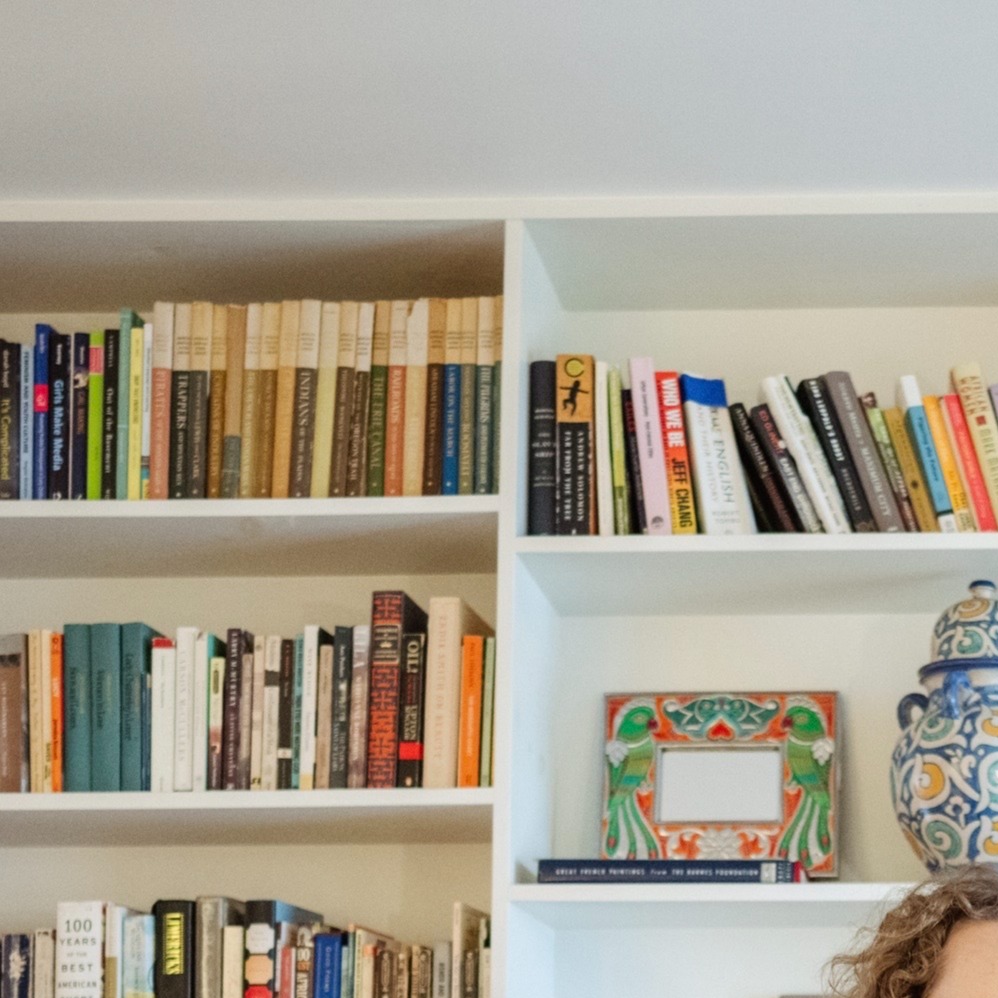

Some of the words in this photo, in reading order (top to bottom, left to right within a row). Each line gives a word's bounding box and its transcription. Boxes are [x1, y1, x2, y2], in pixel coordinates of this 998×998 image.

[53, 380, 64, 404] Girls
[298, 372, 311, 426] INDIANS
[374, 377, 385, 396] THE
[662, 379, 679, 407] WHO
[107, 406, 114, 416] of
[177, 375, 189, 429] TRAPPERS
[53, 407, 64, 433] Make
[665, 409, 682, 429] WE
[1, 417, 11, 480] Complicated
[669, 432, 684, 448] BE
[53, 437, 63, 471] Media
[105, 434, 113, 474] Basement
[562, 450, 571, 475] FROM
[672, 457, 688, 485] JEFF
[563, 478, 571, 495] THE
[676, 488, 693, 528] CHANG
[406, 640, 420, 673] OIL!
[409, 705, 418, 740] UPTON
[65, 919, 93, 933] 100
[60, 938, 97, 946] YEARS
[165, 913, 182, 975] LIMERICKS
[62, 963, 92, 973] BEST
[58, 979, 98, 988] AMERICAN
